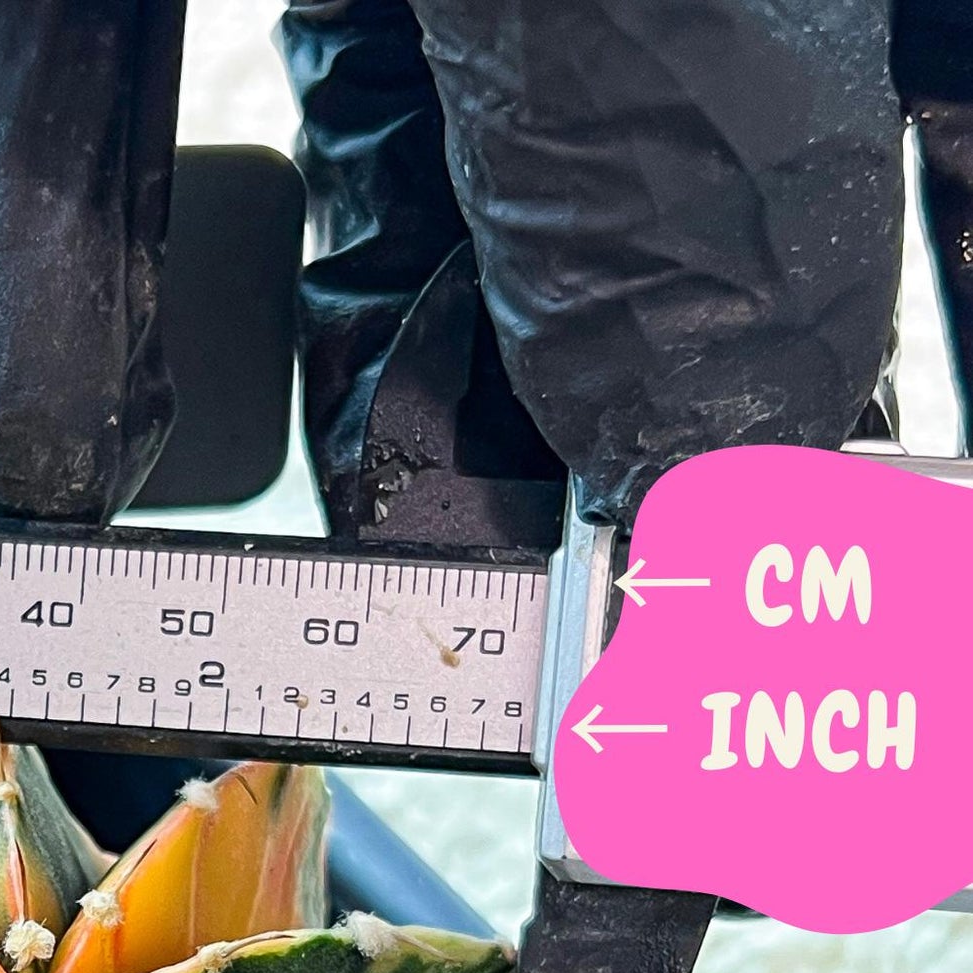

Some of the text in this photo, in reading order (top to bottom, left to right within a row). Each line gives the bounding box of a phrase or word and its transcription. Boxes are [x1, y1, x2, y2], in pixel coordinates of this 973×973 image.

[20, 600, 74, 628] 40
[160, 608, 215, 637] 50
[303, 618, 359, 646] 60
[452, 626, 506, 656] 70
[32, 668, 48, 686] 5
[67, 671, 84, 689] 6
[107, 674, 121, 690] 7
[137, 676, 156, 694] 8
[174, 679, 192, 697] 9
[198, 660, 225, 689] 2
[255, 684, 263, 701] 1
[283, 686, 300, 706] 2
[320, 688, 336, 705] 3
[356, 691, 371, 708] 4
[393, 693, 410, 711] 5
[430, 695, 447, 713] 6
[471, 698, 486, 715] 7
[504, 701, 523, 718] 8
